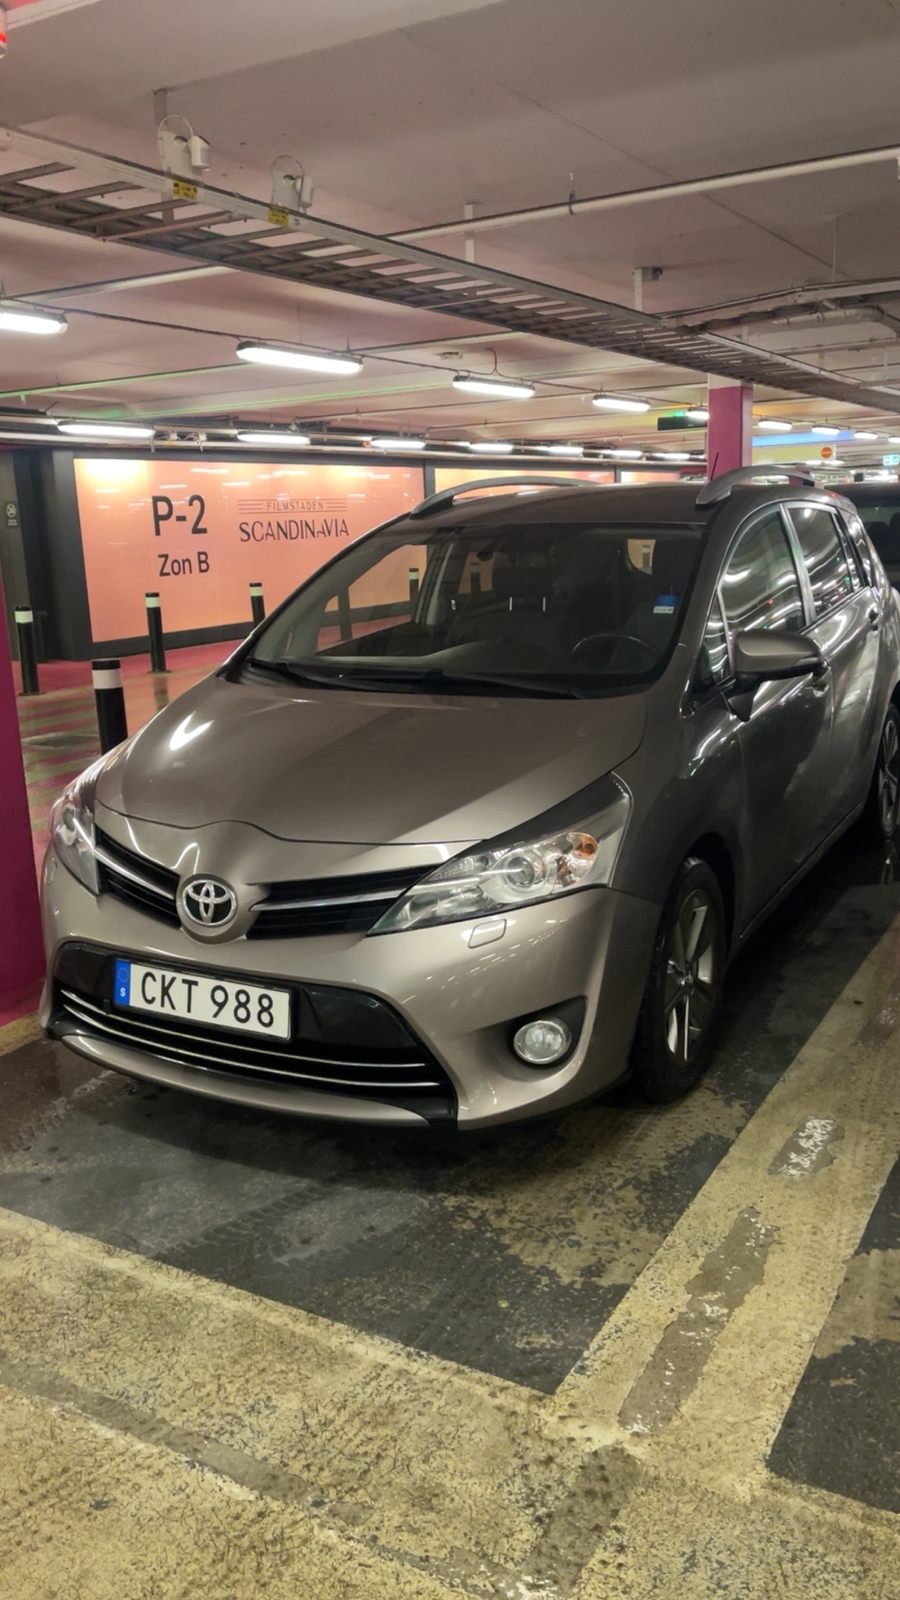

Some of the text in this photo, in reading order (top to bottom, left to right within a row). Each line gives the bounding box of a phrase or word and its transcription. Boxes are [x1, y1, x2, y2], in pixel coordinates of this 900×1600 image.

[152, 494, 207, 536] P-2
[266, 501, 324, 511] FILMSTADEN
[239, 518, 349, 542] SCANDINAVIA
[158, 551, 210, 577] Zon B
[119, 987, 126, 997] S
[141, 971, 274, 1028] CKT 988
